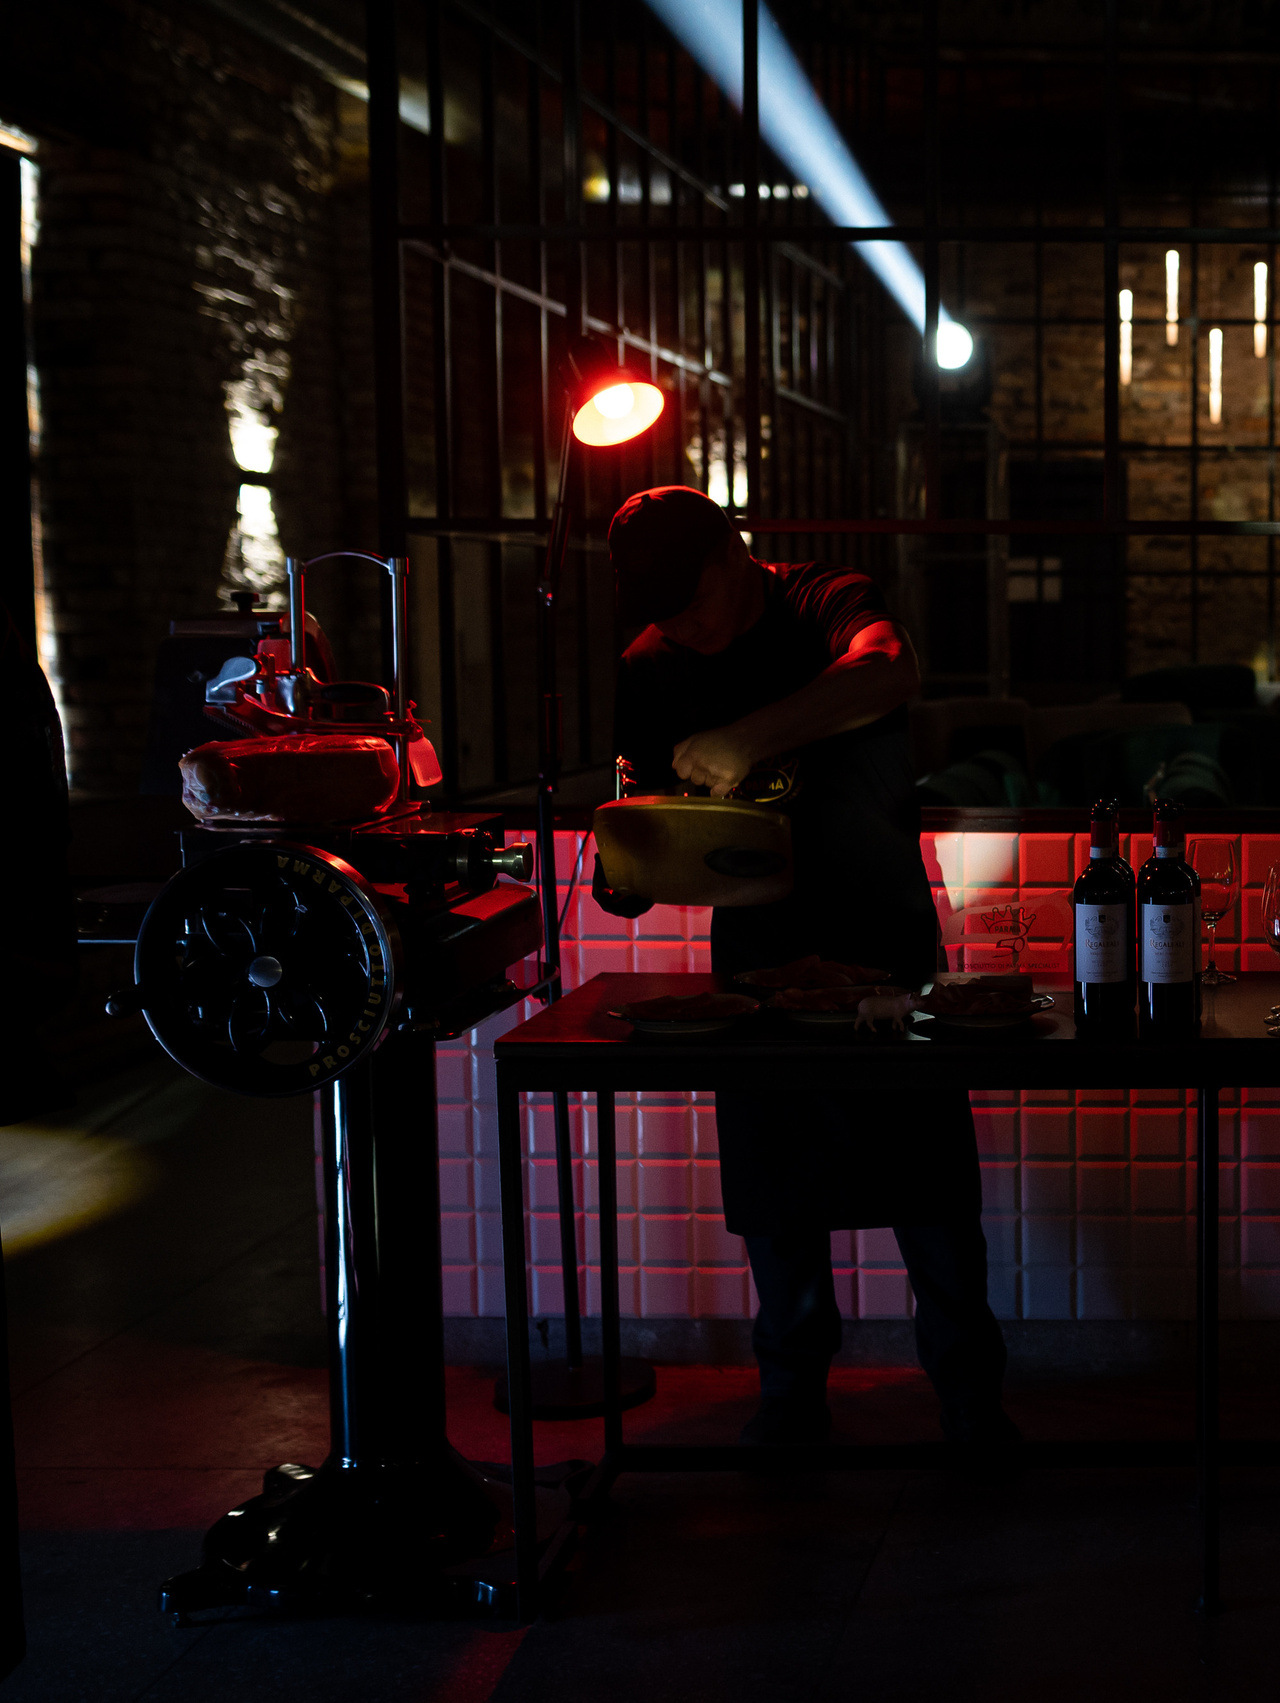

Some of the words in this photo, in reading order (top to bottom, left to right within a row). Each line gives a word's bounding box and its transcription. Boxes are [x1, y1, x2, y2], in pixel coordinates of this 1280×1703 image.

[276, 855, 354, 907] PARMA
[353, 909, 375, 936] DI
[308, 944, 384, 1077] PROSCIUTTO
